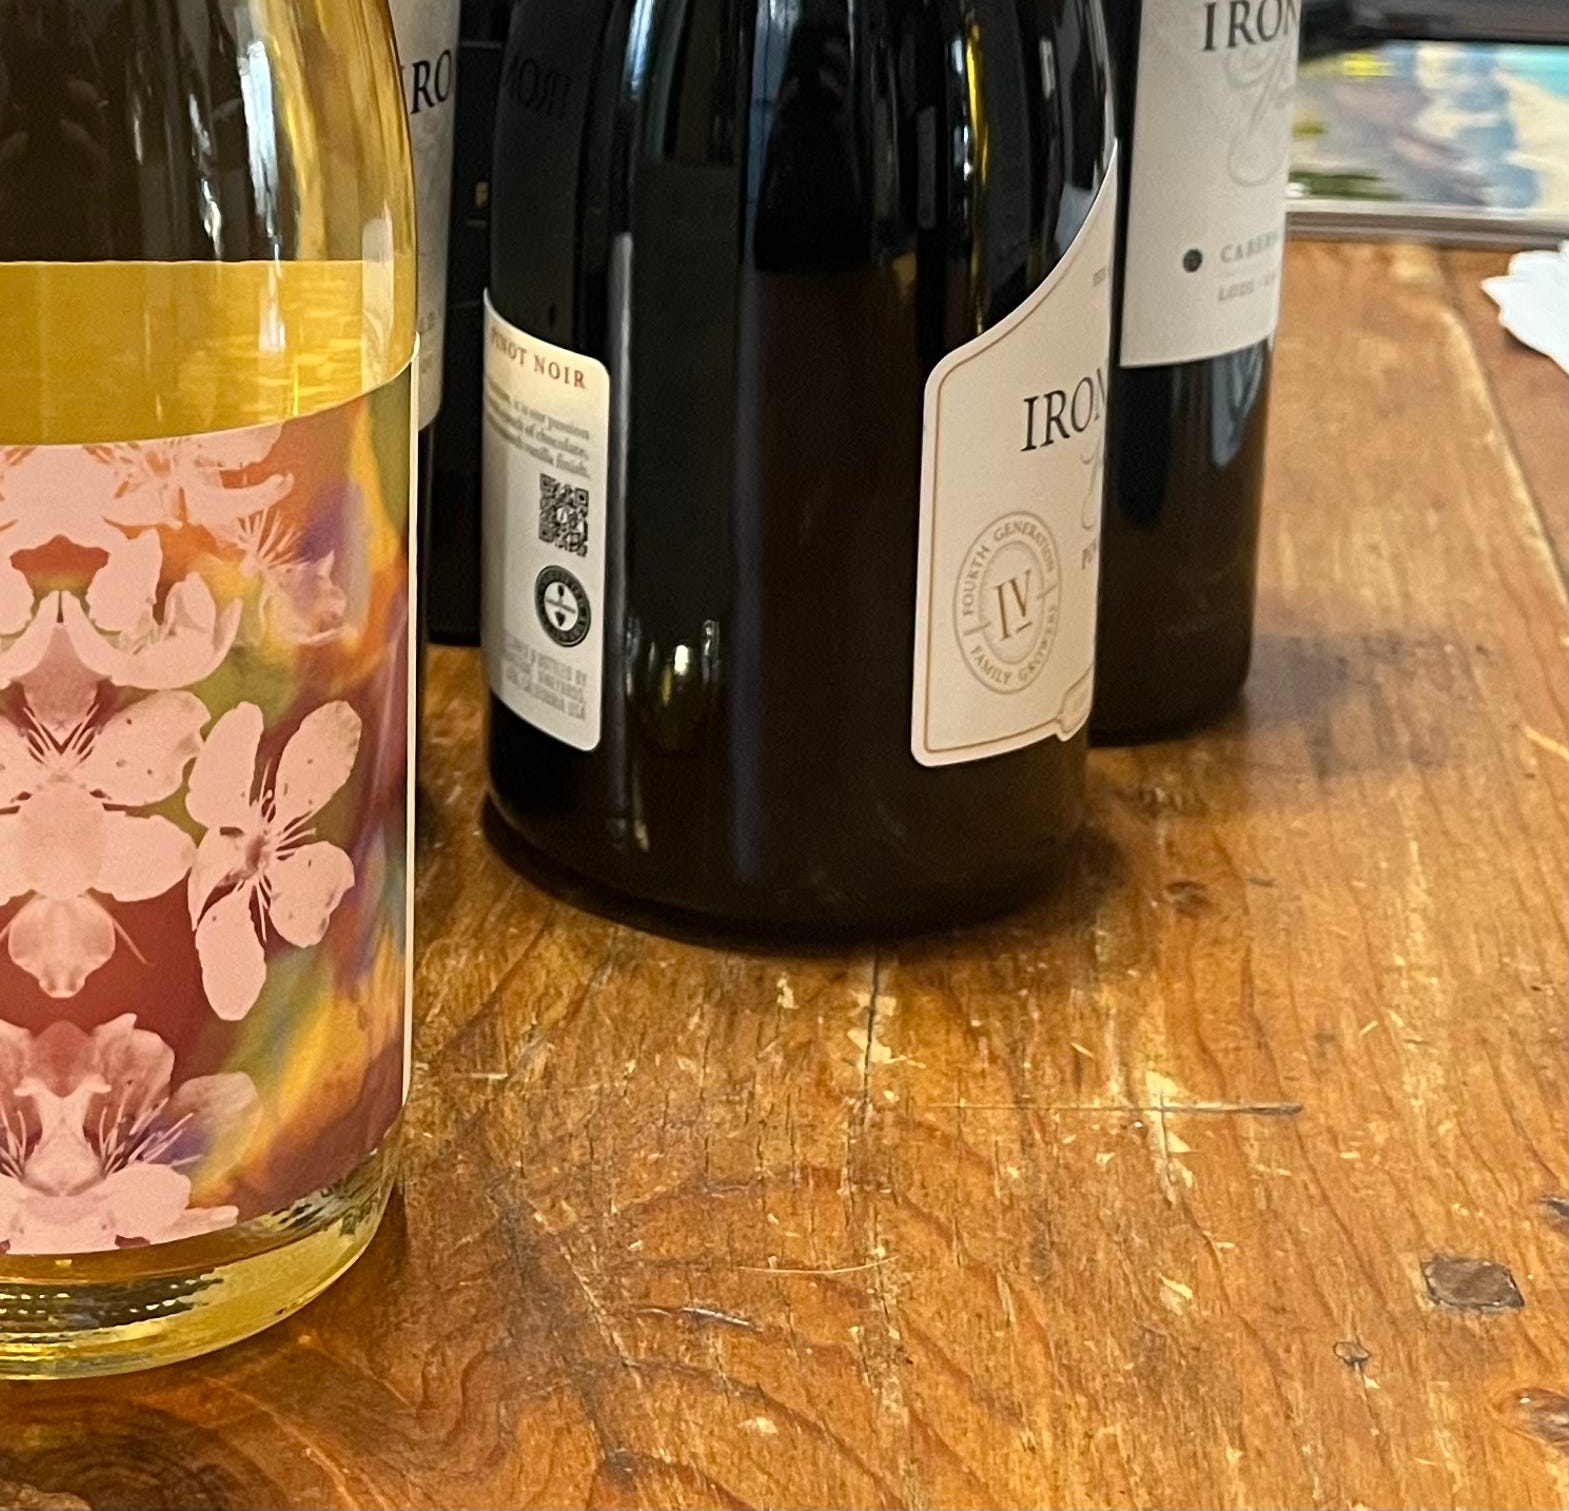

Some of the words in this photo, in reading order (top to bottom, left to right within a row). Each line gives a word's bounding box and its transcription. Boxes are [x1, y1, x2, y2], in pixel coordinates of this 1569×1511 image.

[400, 49, 453, 115] RO
[533, 354, 586, 389] NOIR
[962, 544, 992, 617] FOURTH
[992, 568, 1032, 641] IV
[970, 644, 1013, 686] FAMILY
